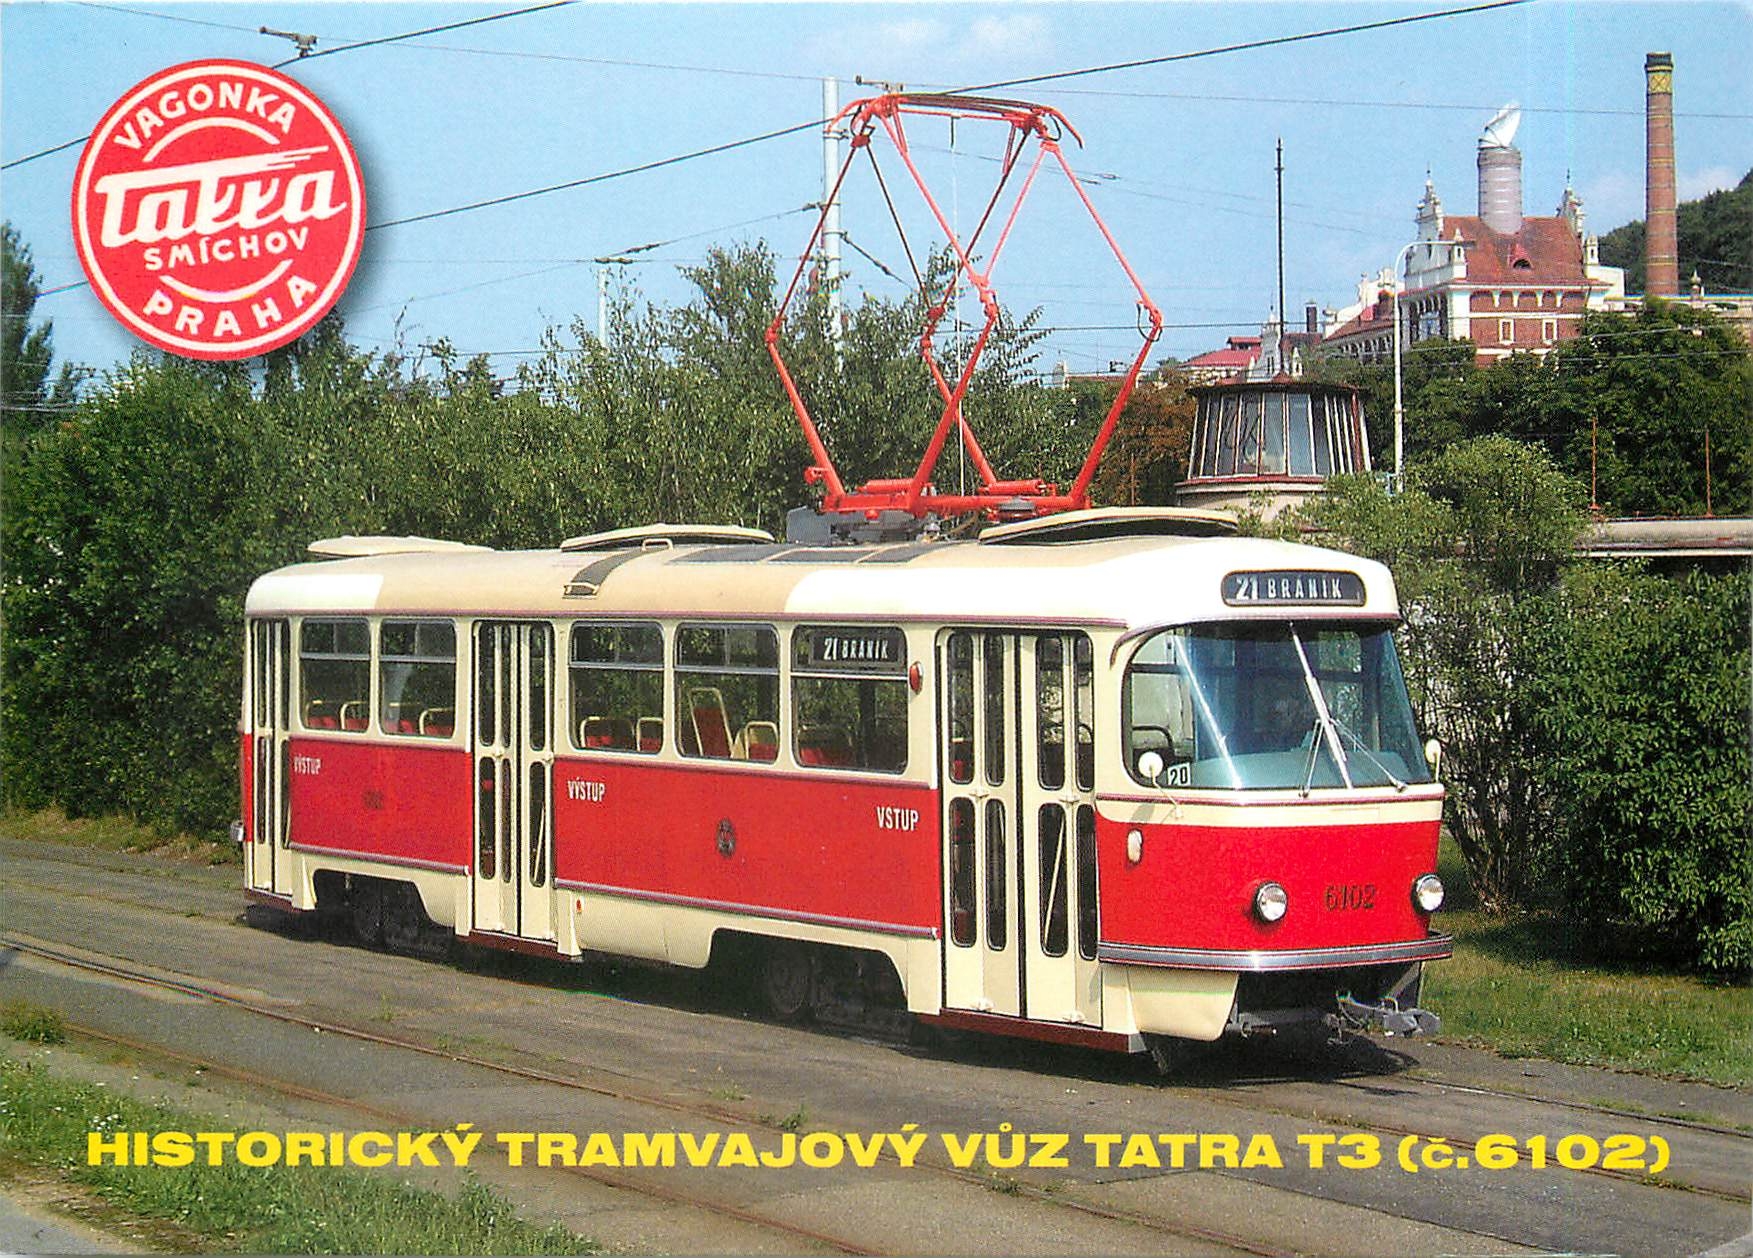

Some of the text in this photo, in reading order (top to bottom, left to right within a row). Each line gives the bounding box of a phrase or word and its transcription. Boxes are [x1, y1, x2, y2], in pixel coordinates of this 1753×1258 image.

[1235, 576, 1259, 600] 21
[823, 638, 838, 660] 21
[1170, 766, 1188, 785] 20
[567, 777, 606, 802] VÝSTUP
[877, 806, 919, 831] VSTUP
[1324, 884, 1376, 911] 6102
